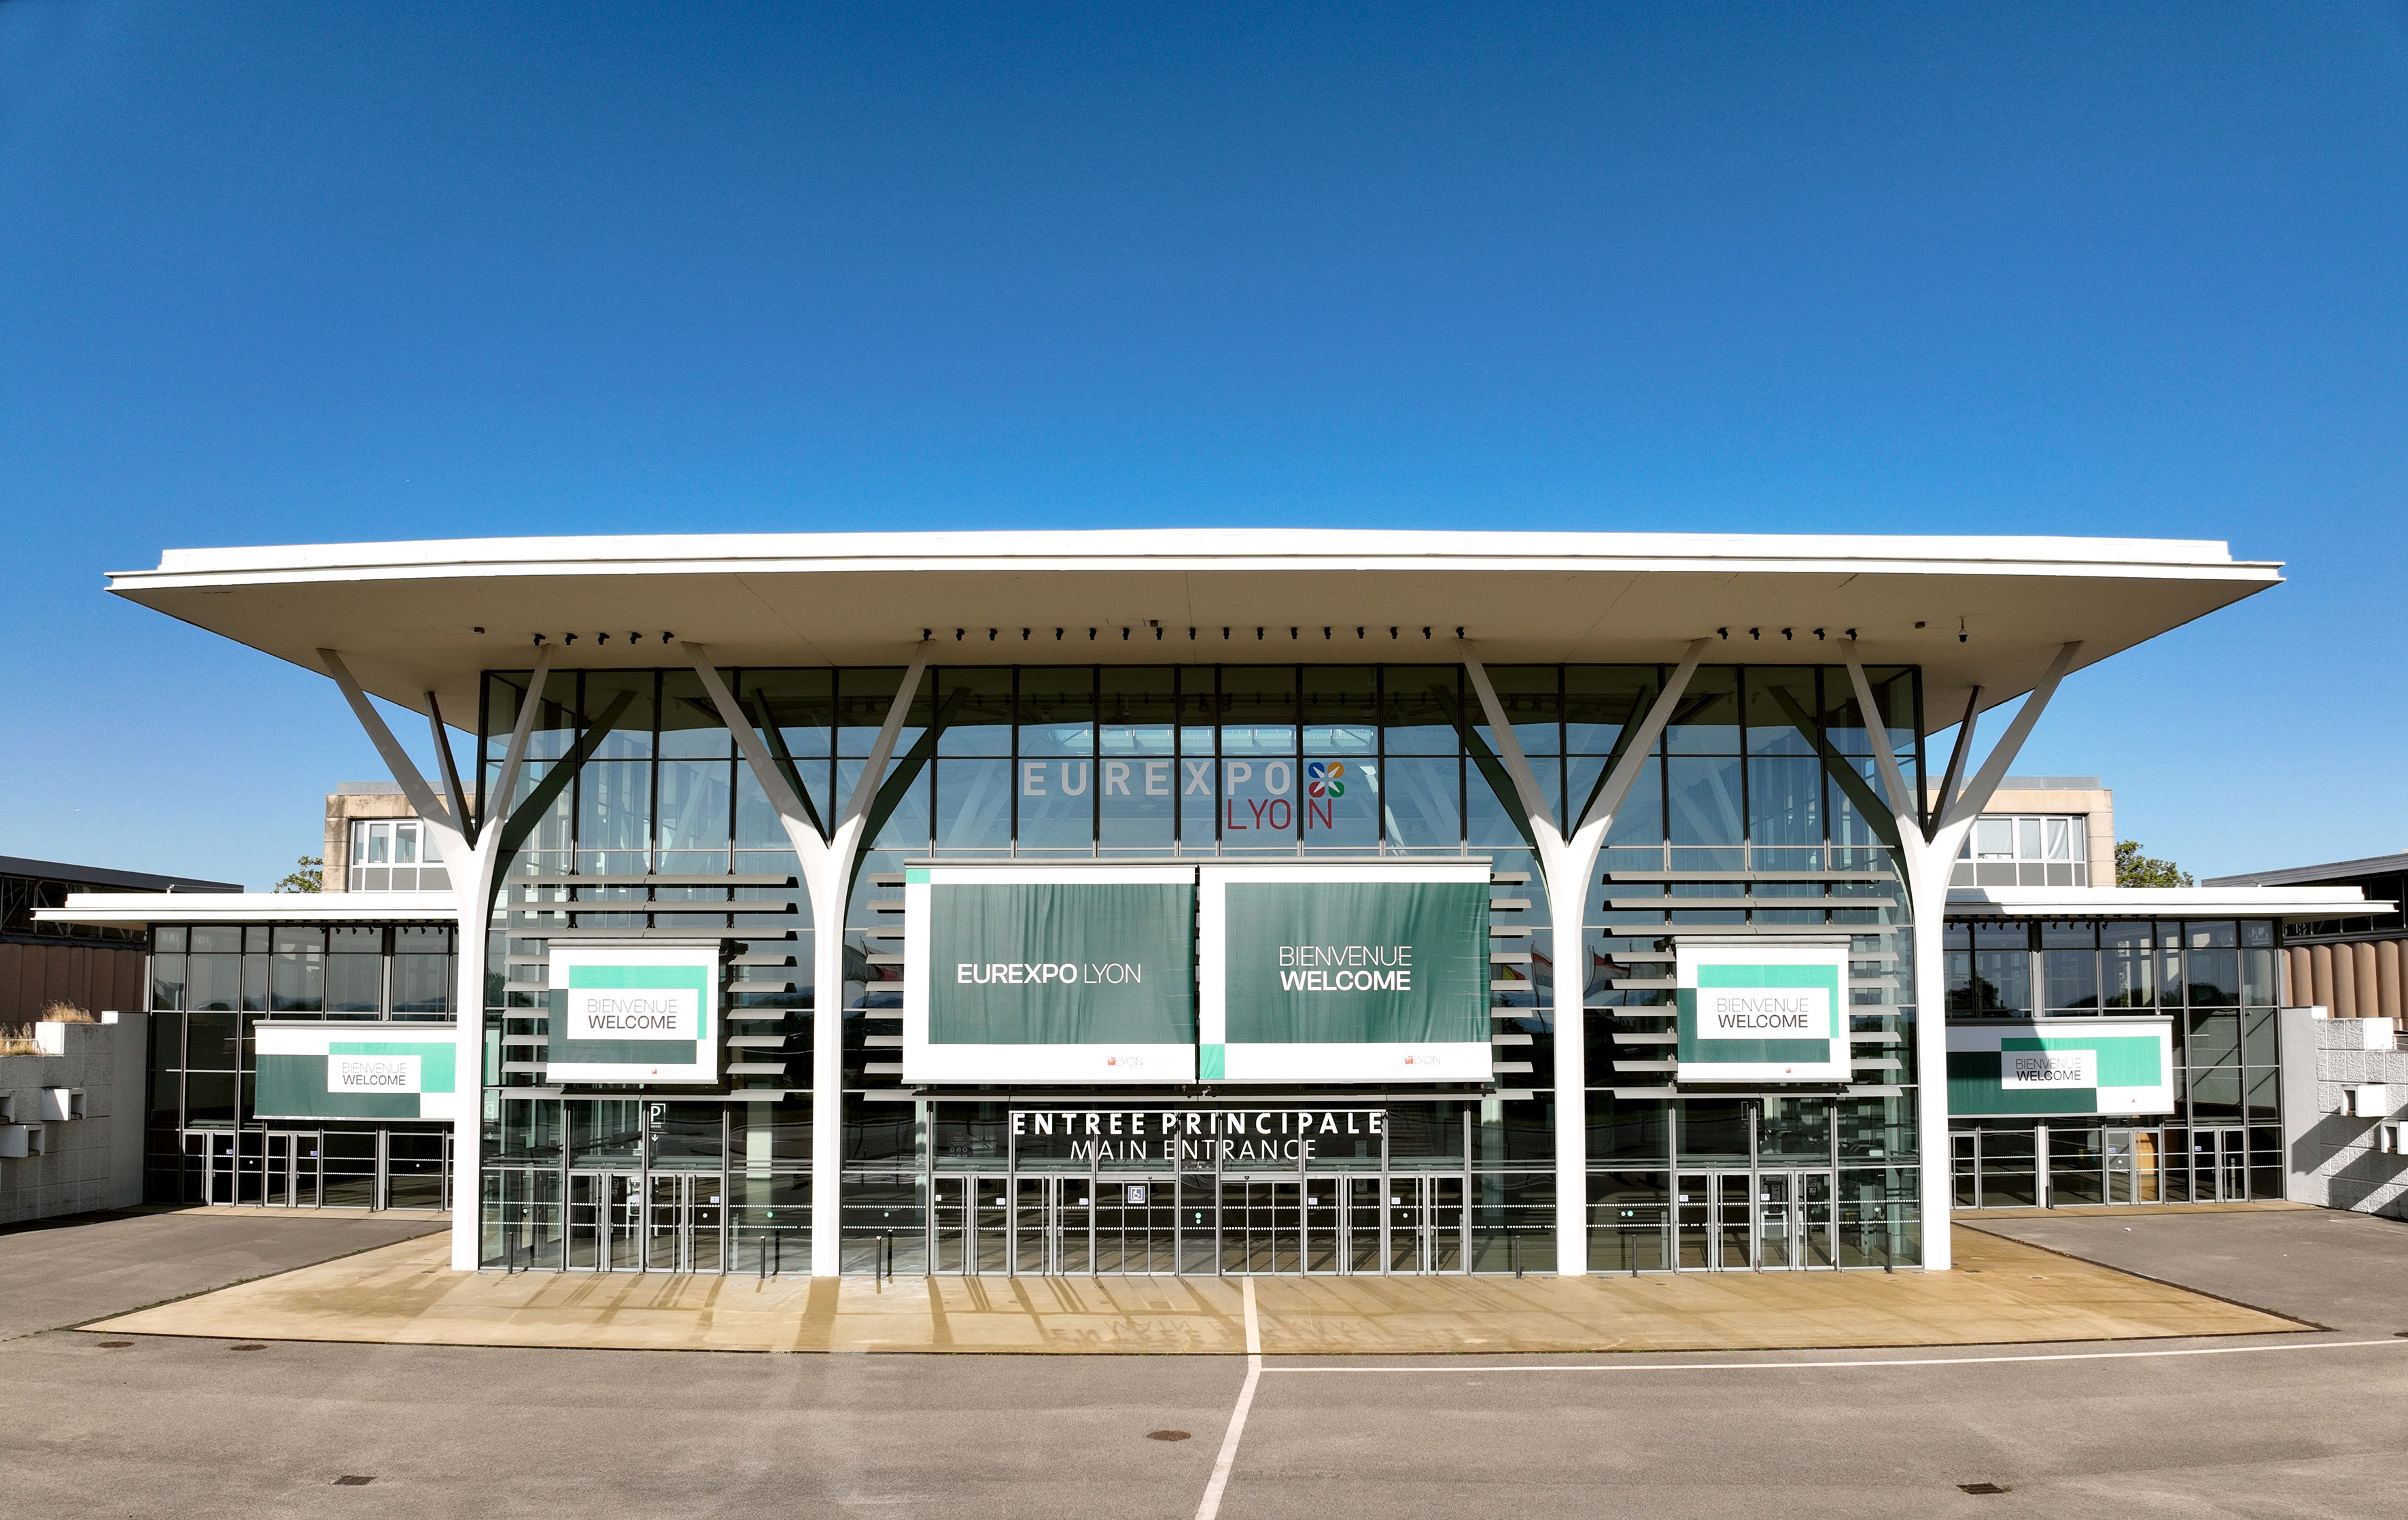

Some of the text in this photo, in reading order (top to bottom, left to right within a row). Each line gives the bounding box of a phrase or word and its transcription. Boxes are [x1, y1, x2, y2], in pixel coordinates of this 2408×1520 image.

[1024, 761, 1290, 796] EUREXPO
[1227, 798, 1332, 830] LYON
[1279, 946, 1412, 967] BIENVENUE
[957, 963, 1141, 984] EUREXPO LYON
[1280, 970, 1411, 991] WELCOME
[587, 999, 678, 1014] BIENVENUE
[1717, 998, 1809, 1012] BIENVENUE
[588, 1015, 676, 1029] WELCOME
[1717, 1014, 1808, 1029] WELCOME
[342, 1062, 406, 1074] BIENVENUE
[2015, 1058, 2082, 1070] BIENVENUE
[343, 1074, 406, 1086] WELCOME
[2016, 1070, 2082, 1082] WELCOME
[1013, 1112, 1382, 1135] ENTREE PRINCIPALE
[1070, 1139, 1316, 1160] MAIN ENTRANCE
